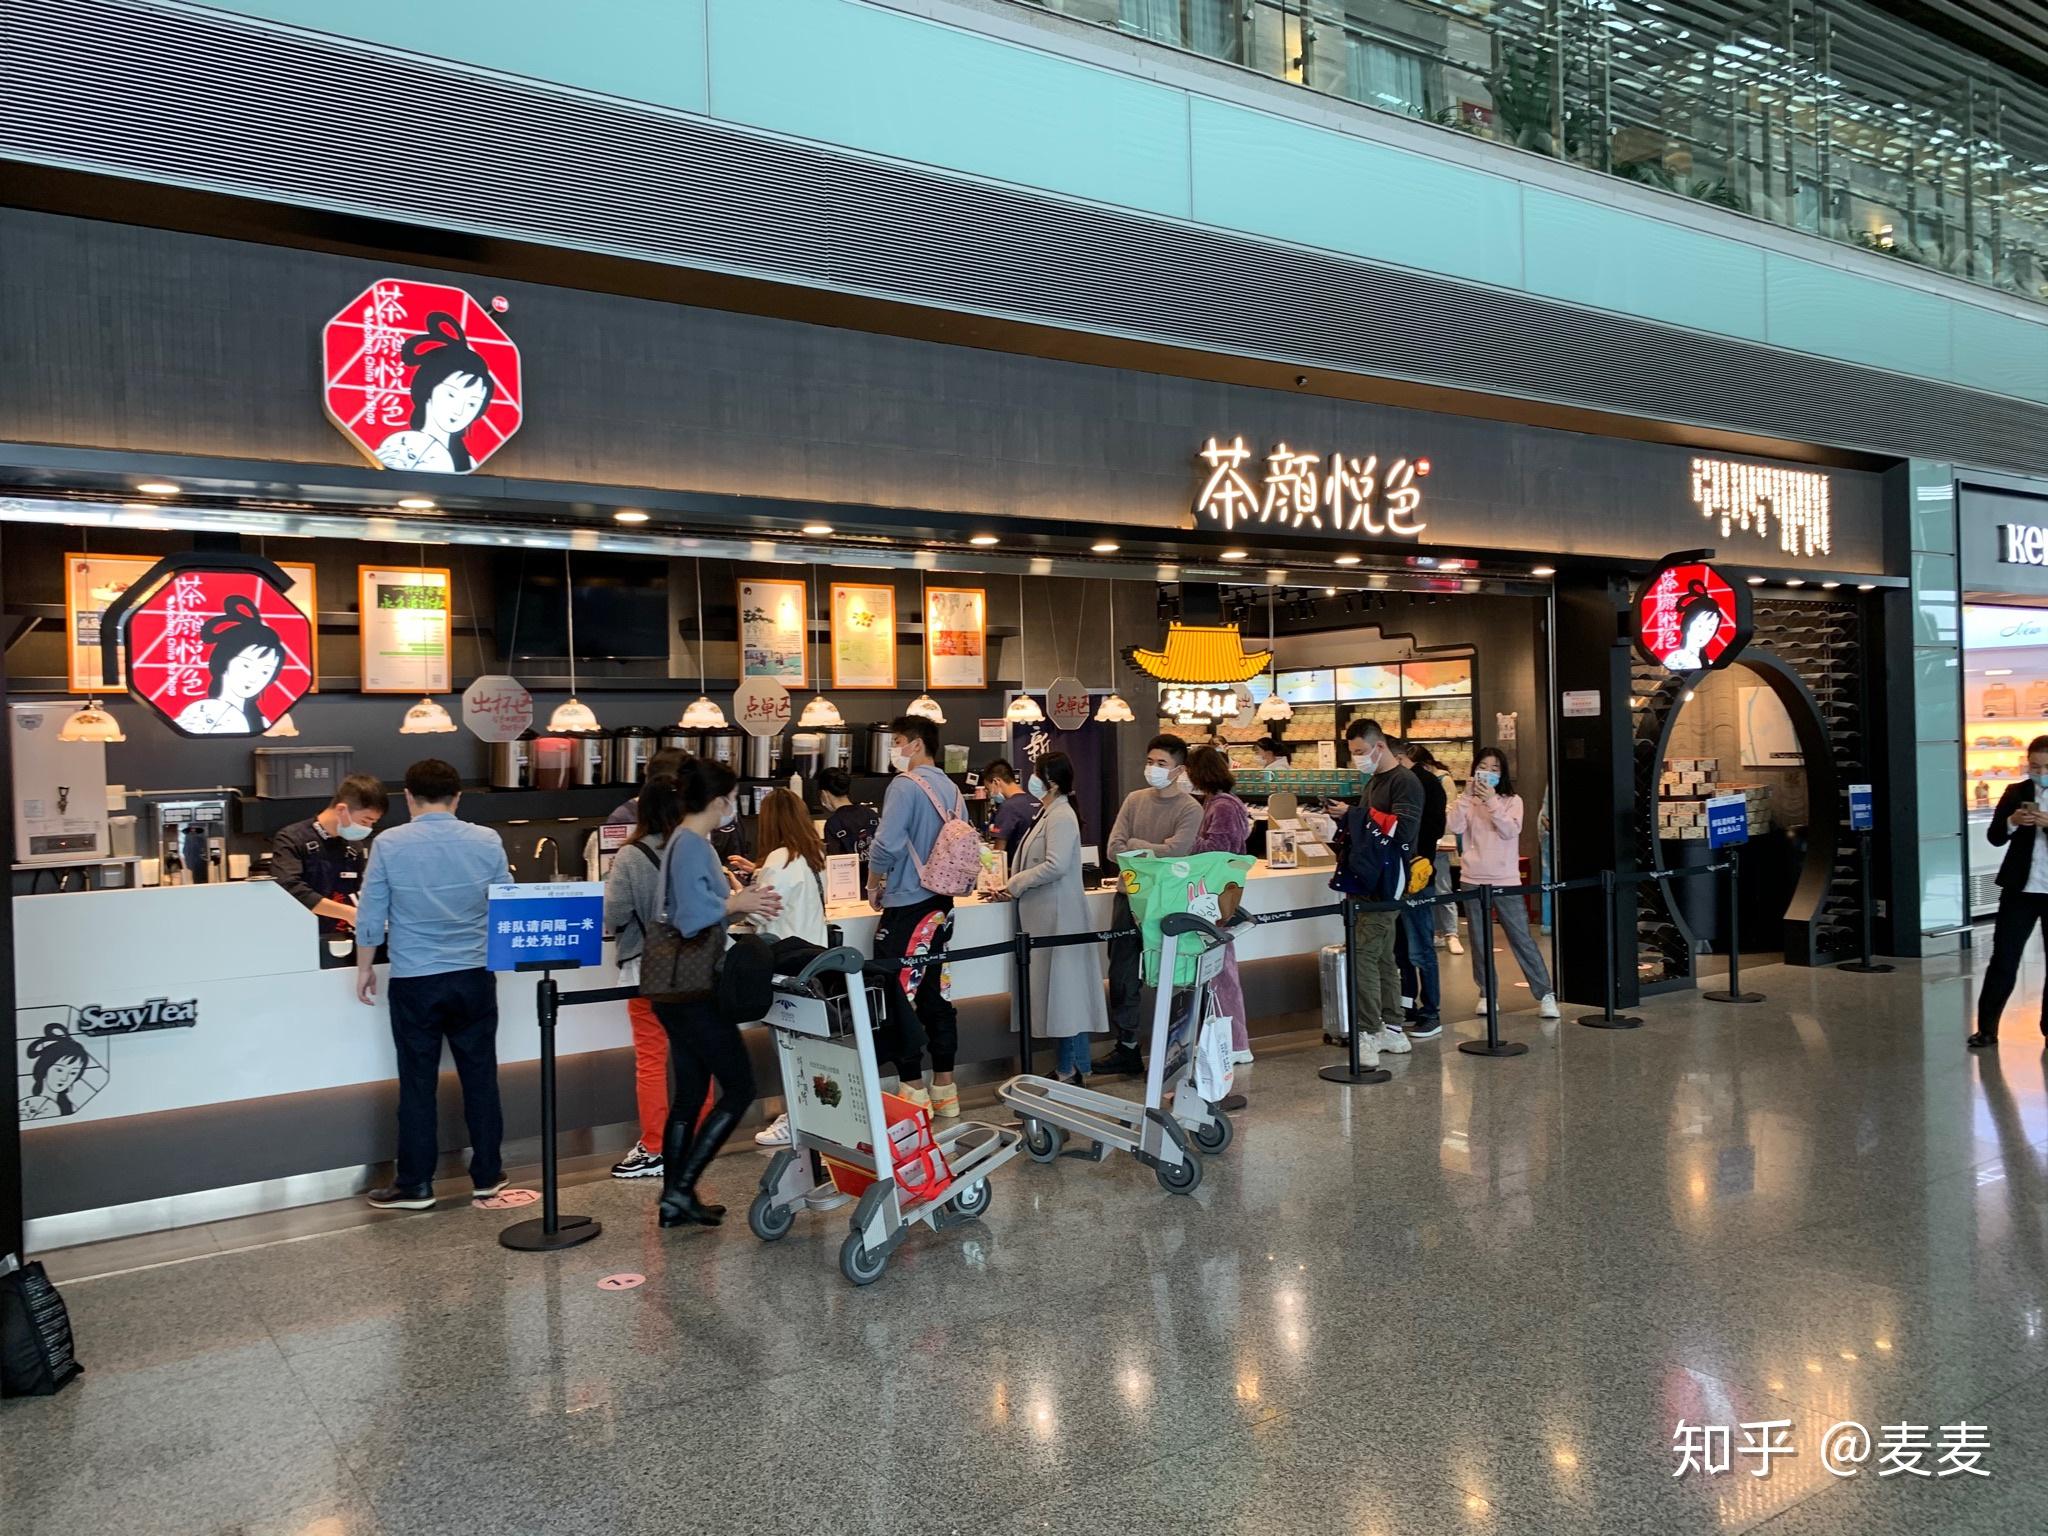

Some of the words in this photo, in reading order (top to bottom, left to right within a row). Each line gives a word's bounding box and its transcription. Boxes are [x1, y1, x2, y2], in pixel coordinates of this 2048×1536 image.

[364, 356, 376, 382] China
[375, 285, 411, 427] 茶颜悦色
[1199, 437, 1428, 535] 茶颜悦色
[2006, 523, 2048, 567] Ke
[175, 575, 209, 697] 茶颜悦色
[743, 695, 791, 721] 点单区
[1053, 694, 1089, 717] 点单区
[497, 918, 594, 933] 排队请间隔一米
[511, 934, 580, 948] 此处为出口
[80, 998, 196, 1031] SexyTea
